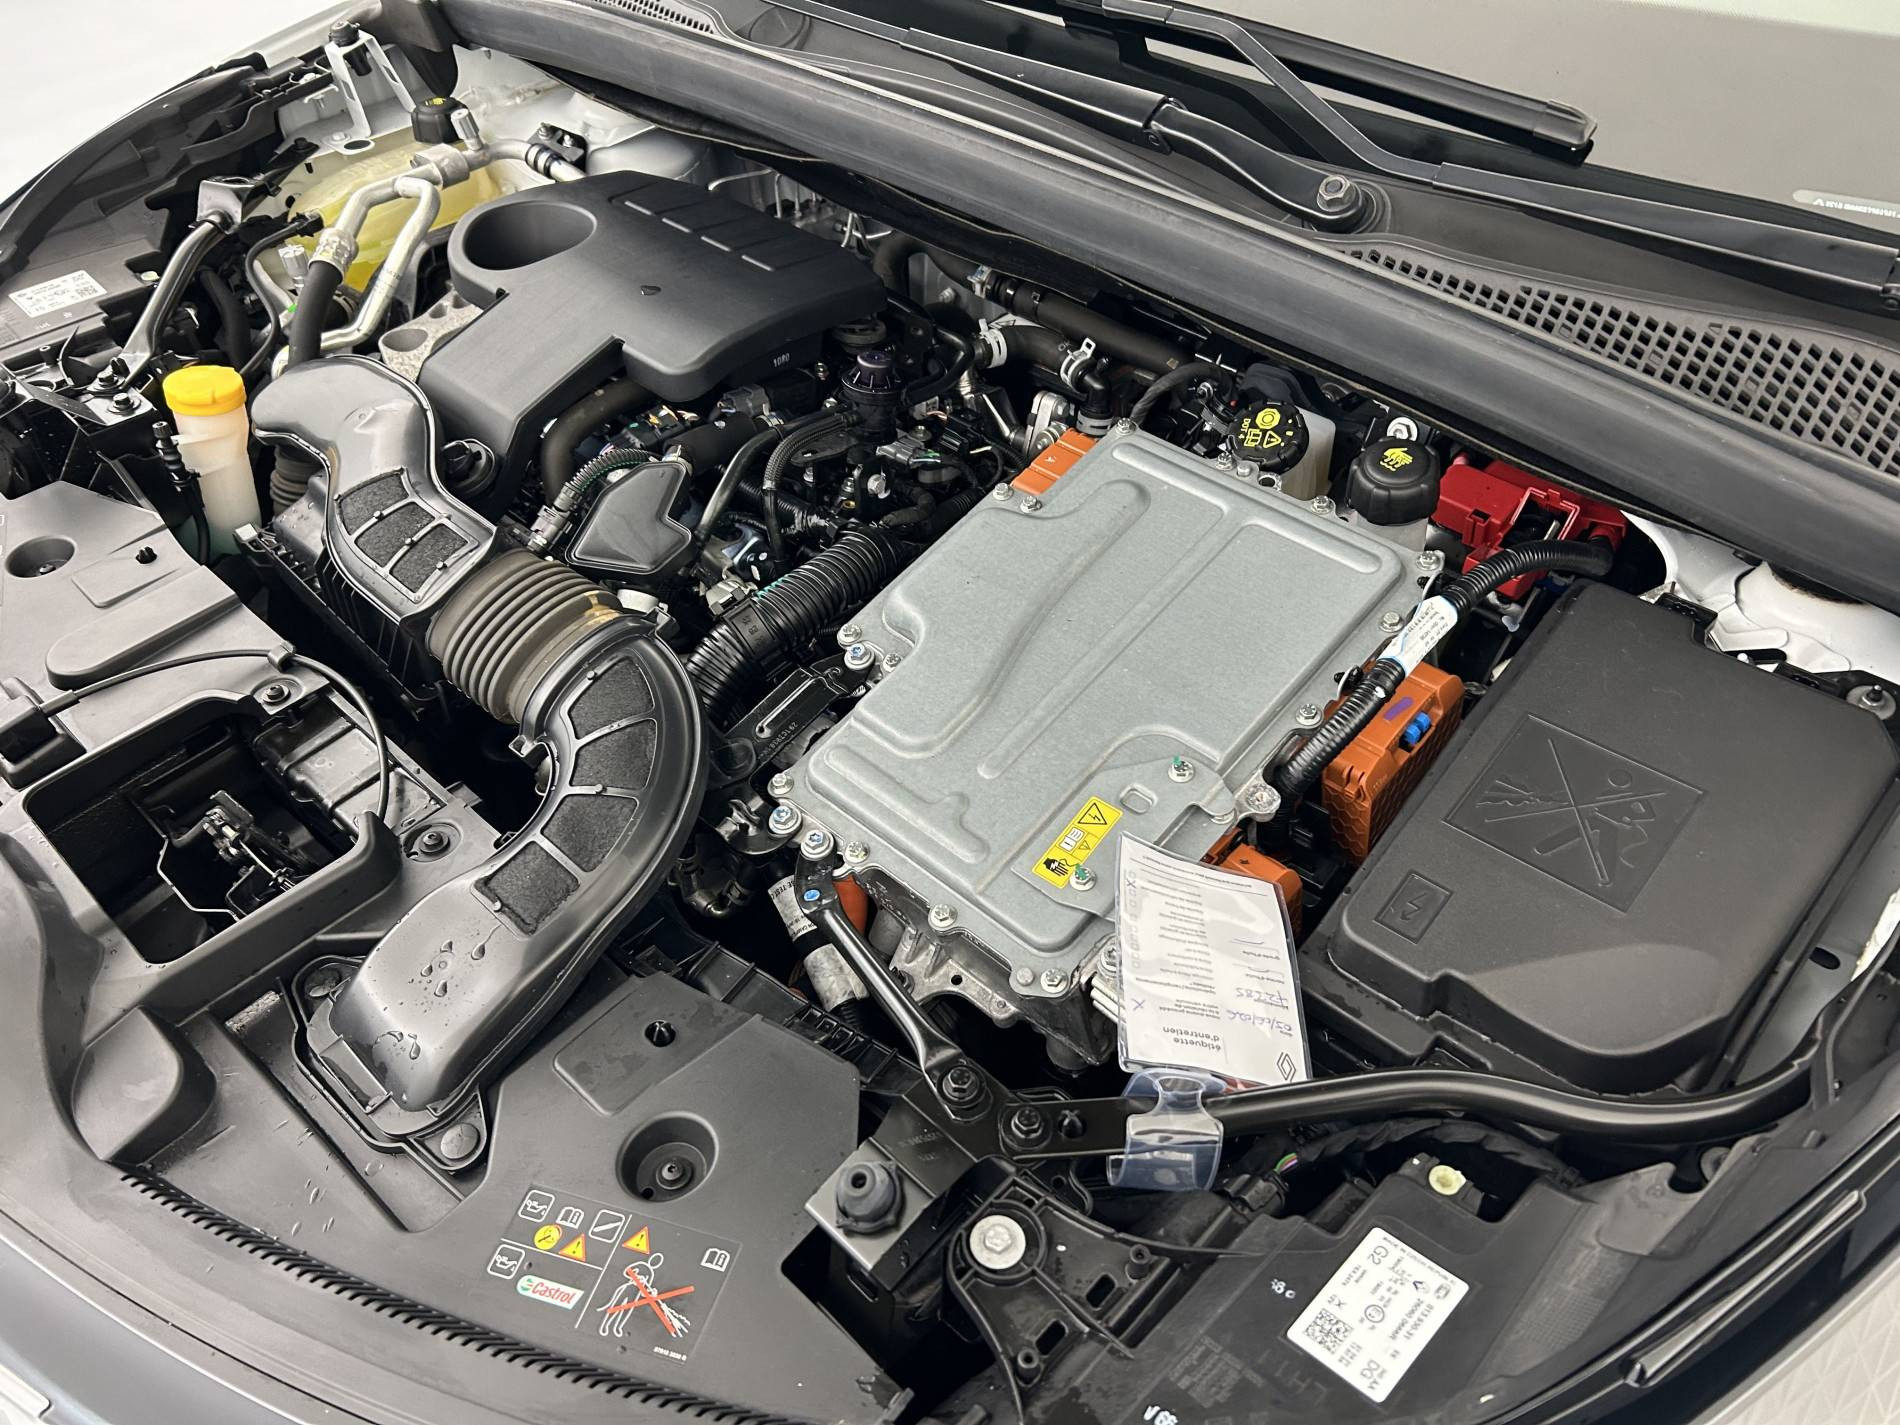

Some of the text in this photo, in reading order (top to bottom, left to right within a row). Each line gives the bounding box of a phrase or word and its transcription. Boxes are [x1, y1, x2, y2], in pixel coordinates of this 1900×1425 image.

[1240, 418, 1251, 432] DOT
[1162, 1026, 1219, 1040] d'entretien
[1173, 1037, 1221, 1051] étiquette
[1367, 1245, 1389, 1265] G2
[531, 1281, 576, 1304] Castrol
